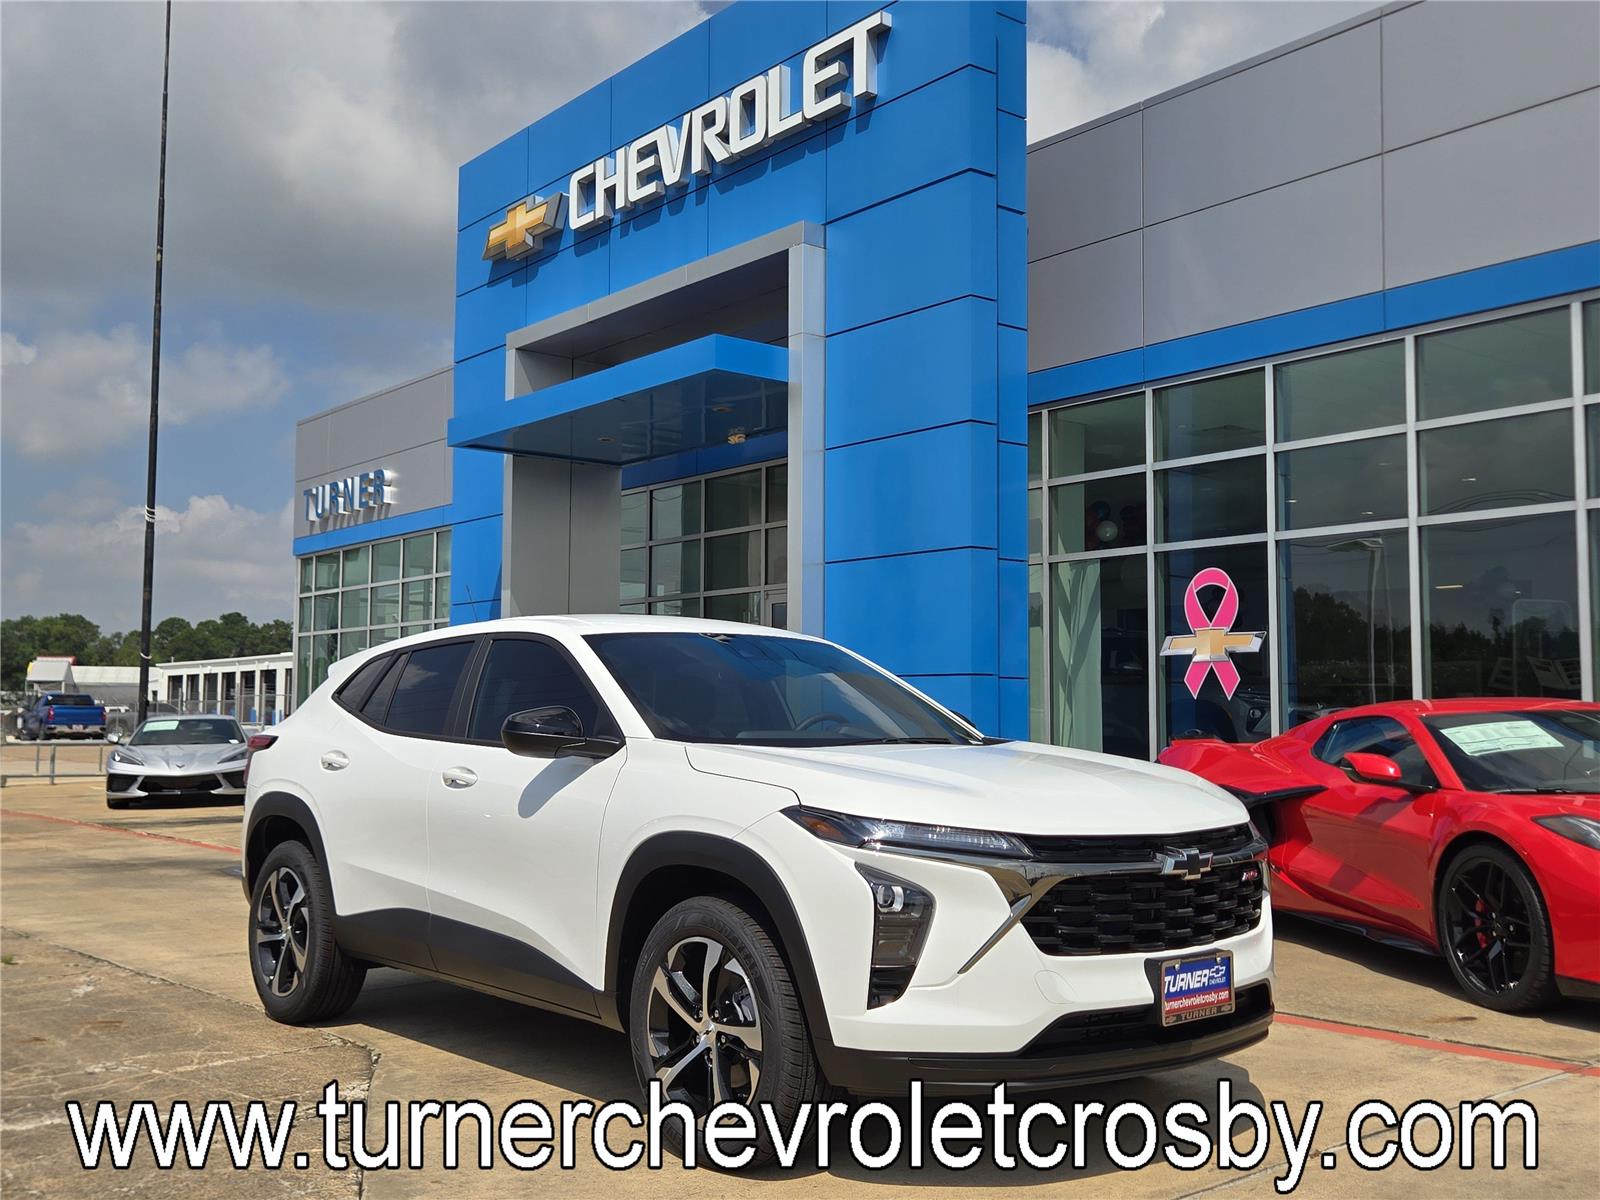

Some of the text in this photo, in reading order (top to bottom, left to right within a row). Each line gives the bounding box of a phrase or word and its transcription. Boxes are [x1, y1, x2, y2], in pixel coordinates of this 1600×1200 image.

[568, 10, 891, 231] CHEVROLET
[304, 469, 390, 521] TURNER
[1164, 968, 1210, 994] TURNER
[1181, 1007, 1217, 1020] TURNER
